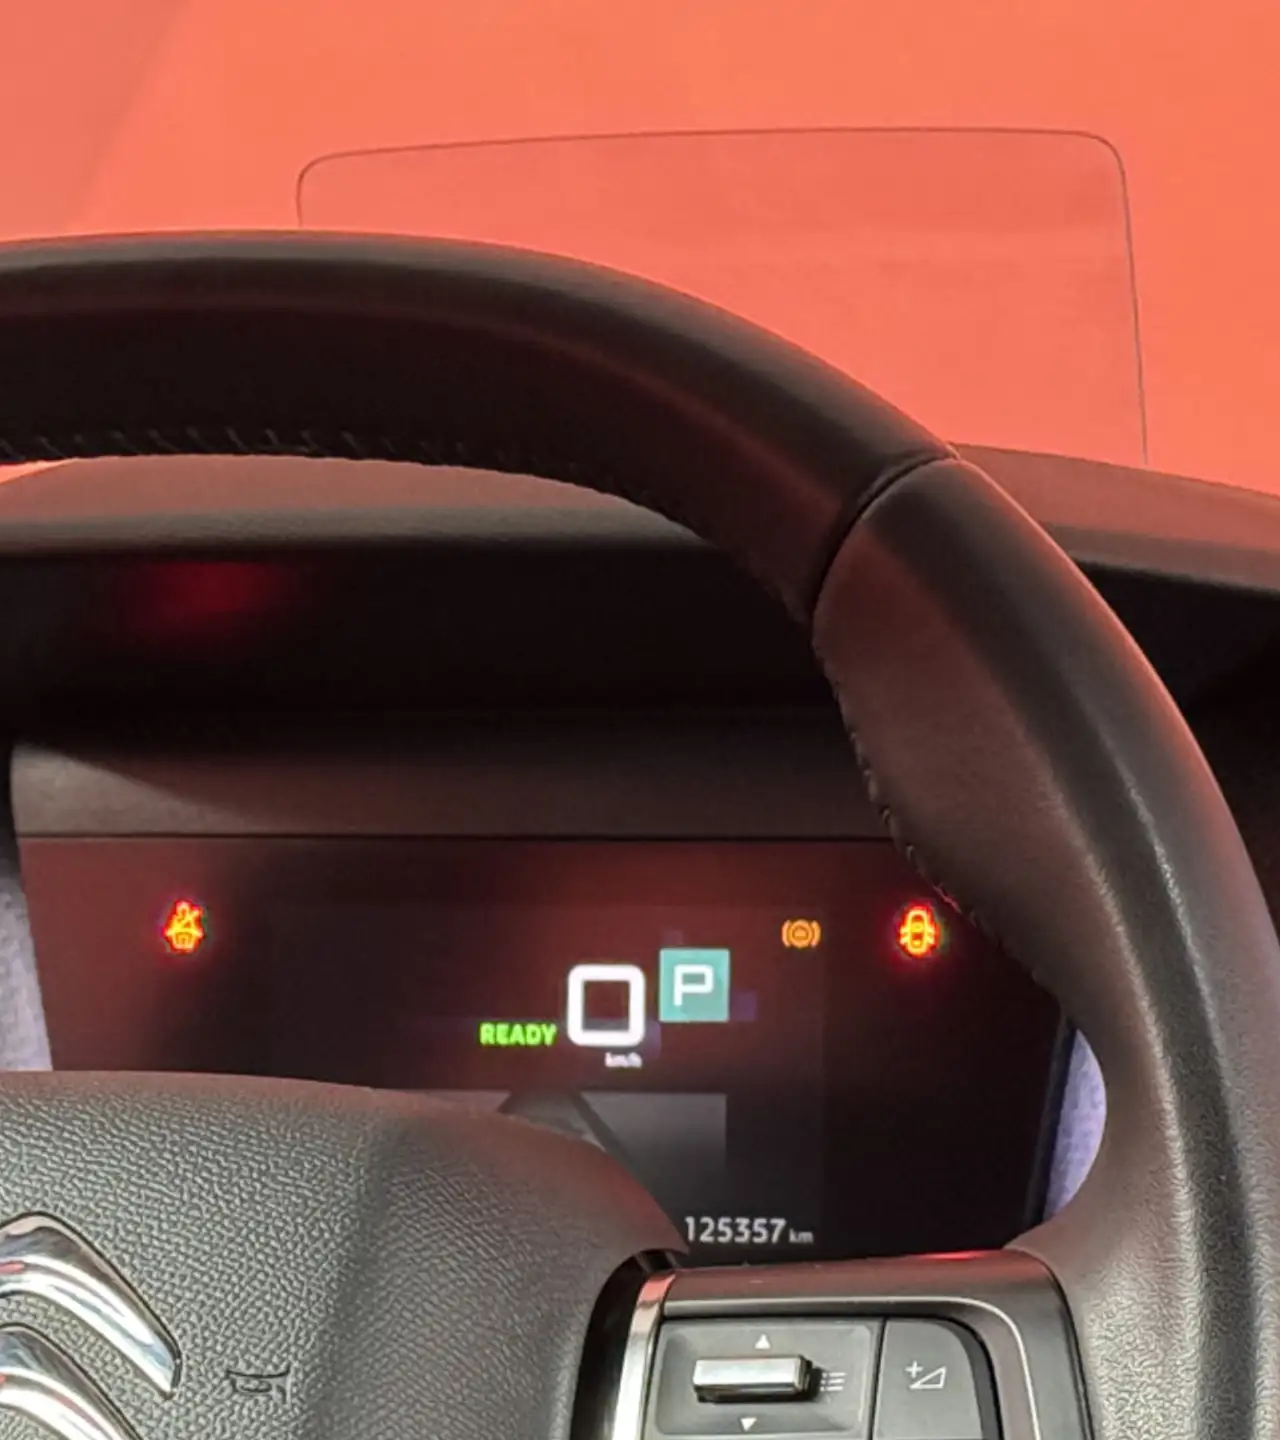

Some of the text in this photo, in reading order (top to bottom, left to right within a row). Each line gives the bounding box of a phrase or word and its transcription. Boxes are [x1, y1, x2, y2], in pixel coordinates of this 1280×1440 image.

[673, 964, 715, 1008] P
[479, 1022, 558, 1046] READY
[685, 1215, 815, 1244] 125357 km
